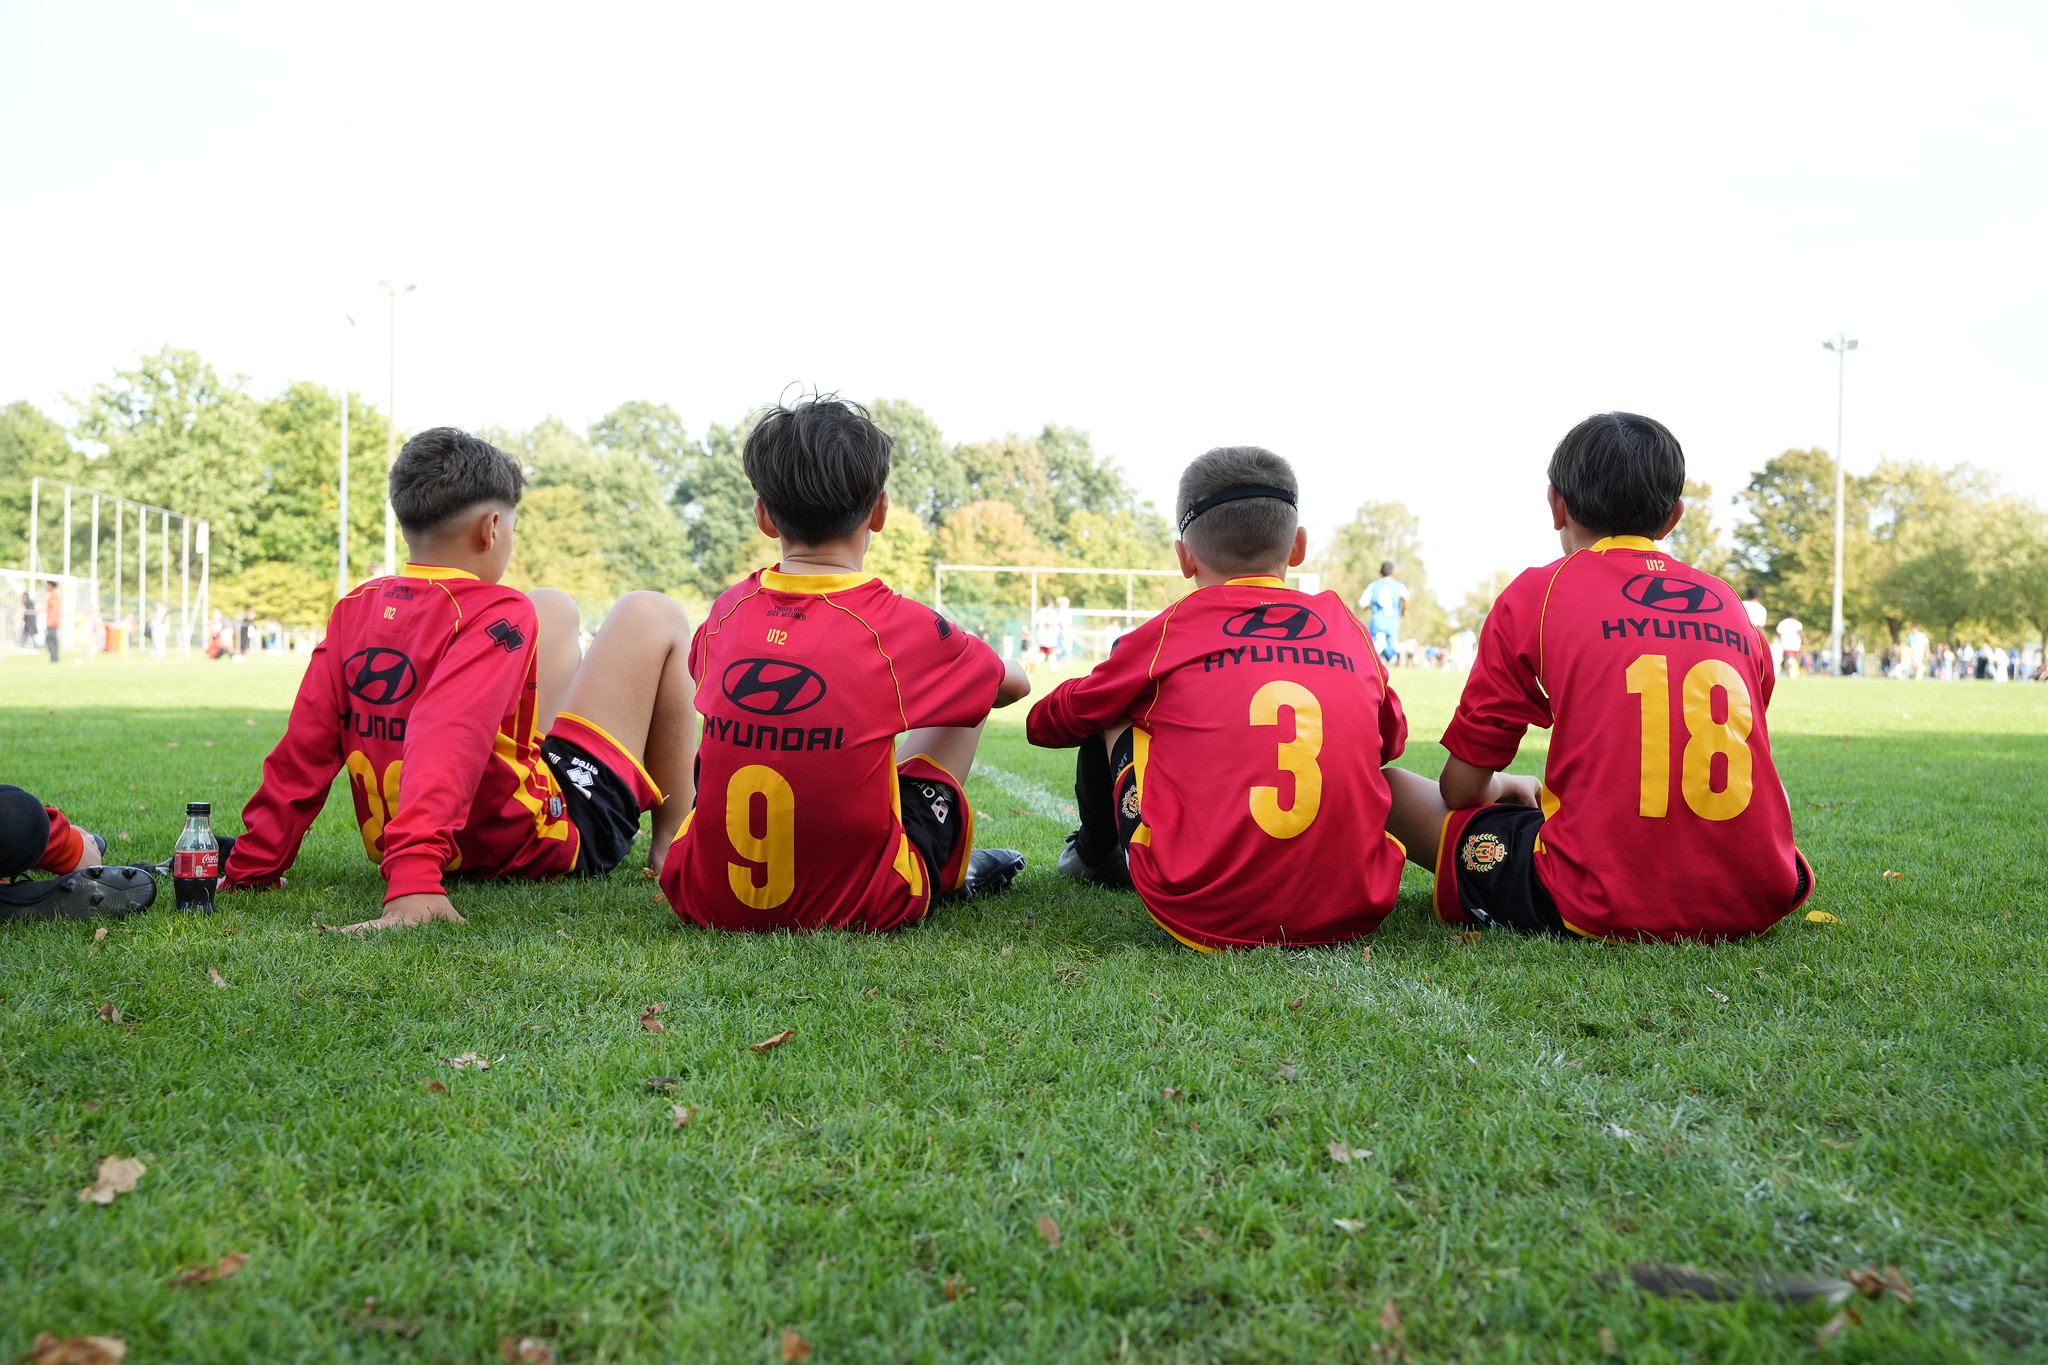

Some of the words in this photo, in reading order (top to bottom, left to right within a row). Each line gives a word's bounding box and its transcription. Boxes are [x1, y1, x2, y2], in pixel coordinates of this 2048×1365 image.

[1645, 559, 1667, 572] U12
[383, 606, 396, 620] U12
[766, 628, 788, 646] U12
[1602, 618, 1750, 656] HYUNDAI
[1204, 645, 1355, 673] HYUNDAI
[704, 714, 843, 751] HYUNDAI
[1625, 654, 1752, 821] 18
[1249, 680, 1323, 839] 3
[726, 764, 795, 910] 9
